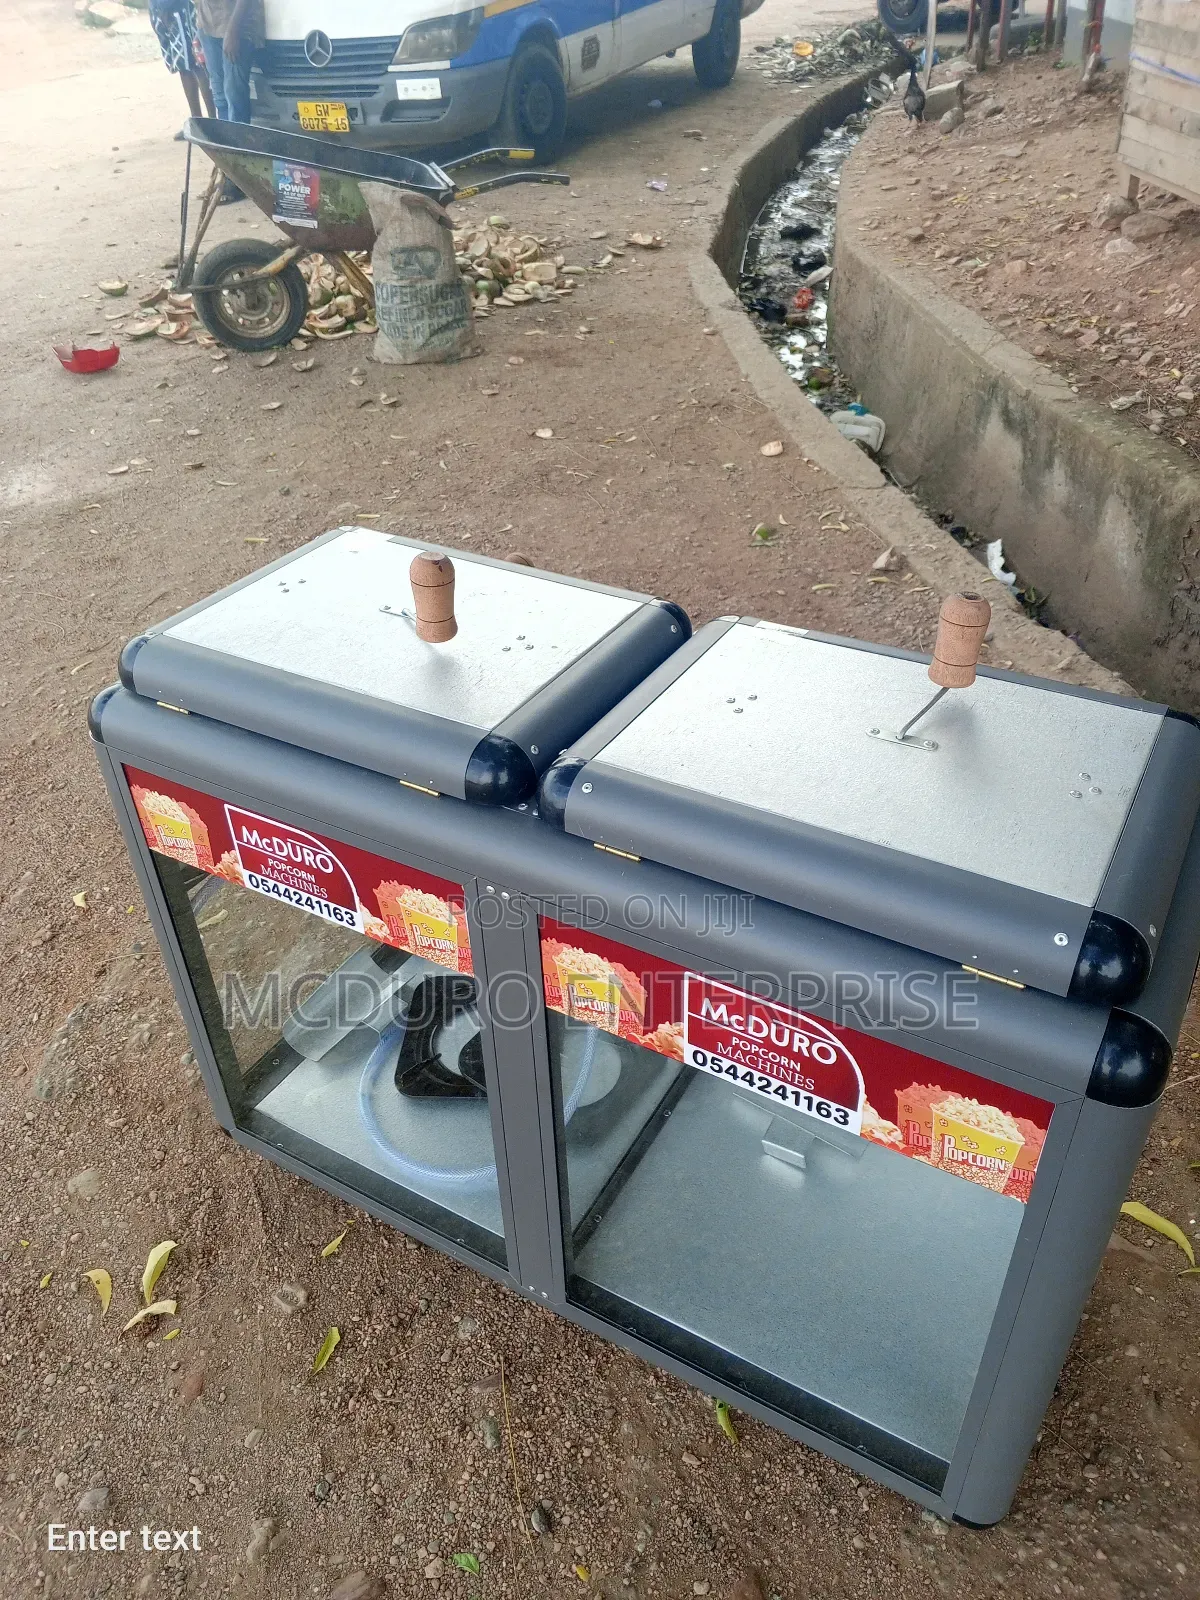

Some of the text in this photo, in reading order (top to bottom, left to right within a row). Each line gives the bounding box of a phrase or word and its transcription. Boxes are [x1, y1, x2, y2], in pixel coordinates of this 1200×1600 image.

[315, 104, 330, 116] GW
[279, 183, 311, 195] POWER
[241, 825, 334, 874] McDURO
[260, 863, 328, 899] MACHINES
[267, 857, 316, 883] POPCORN
[248, 873, 356, 927] 0544241163
[412, 924, 455, 951] POPCORN
[568, 983, 616, 1013] POPCORN
[700, 997, 837, 1065] McDURO
[716, 1041, 815, 1091] MACHINES
[732, 1036, 801, 1072] POPCORN
[692, 1049, 850, 1126] 0544241163
[943, 1134, 1006, 1171] POPCORN
